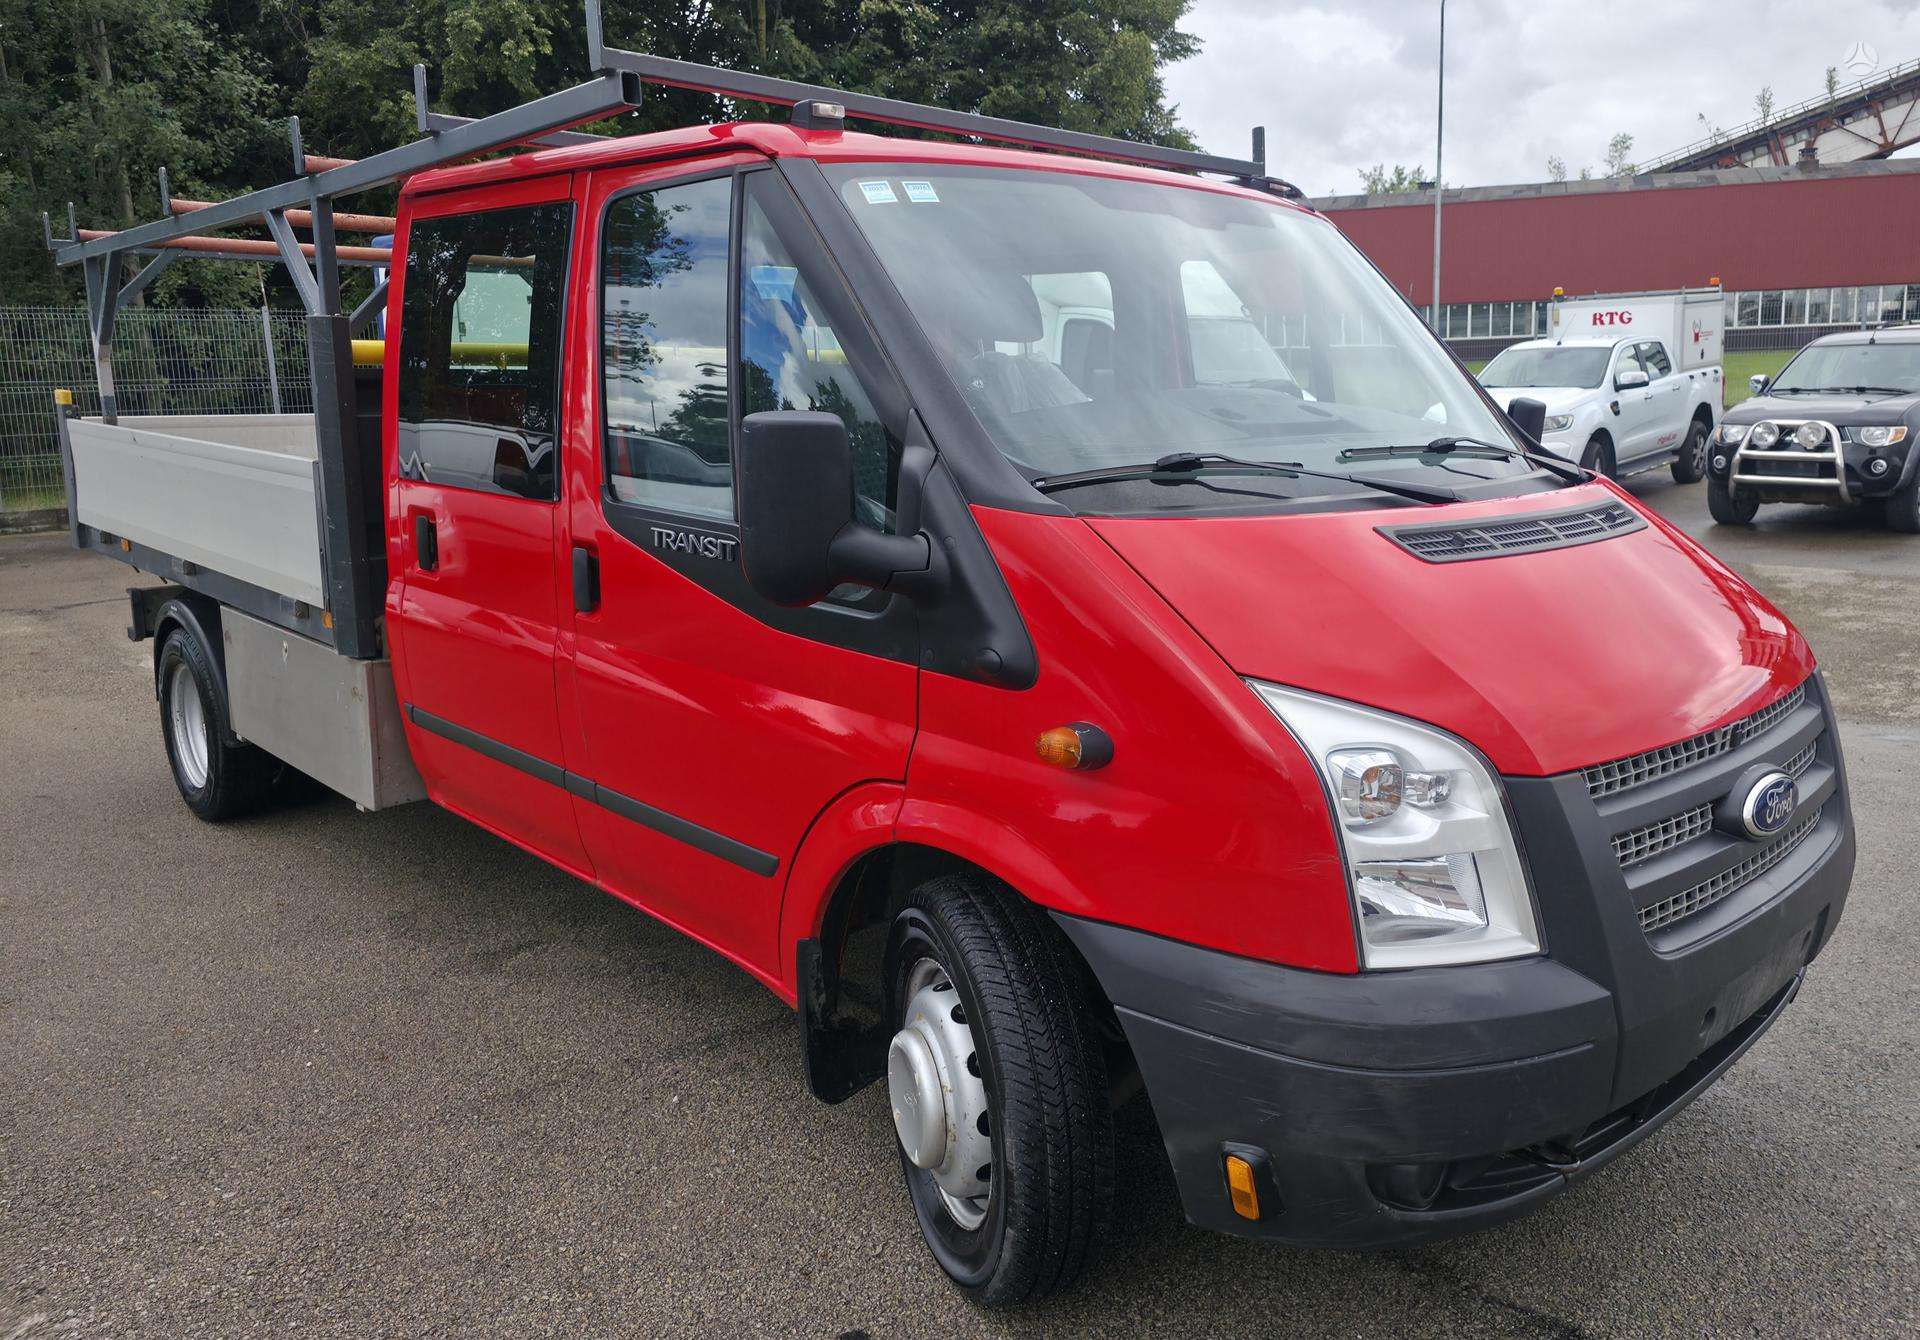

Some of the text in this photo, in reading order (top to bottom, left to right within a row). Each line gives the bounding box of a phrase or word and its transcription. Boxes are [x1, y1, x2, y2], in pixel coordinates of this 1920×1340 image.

[1592, 311, 1632, 326] RTG
[650, 526, 737, 562] TRANSIT
[1766, 784, 1793, 824] Ford
